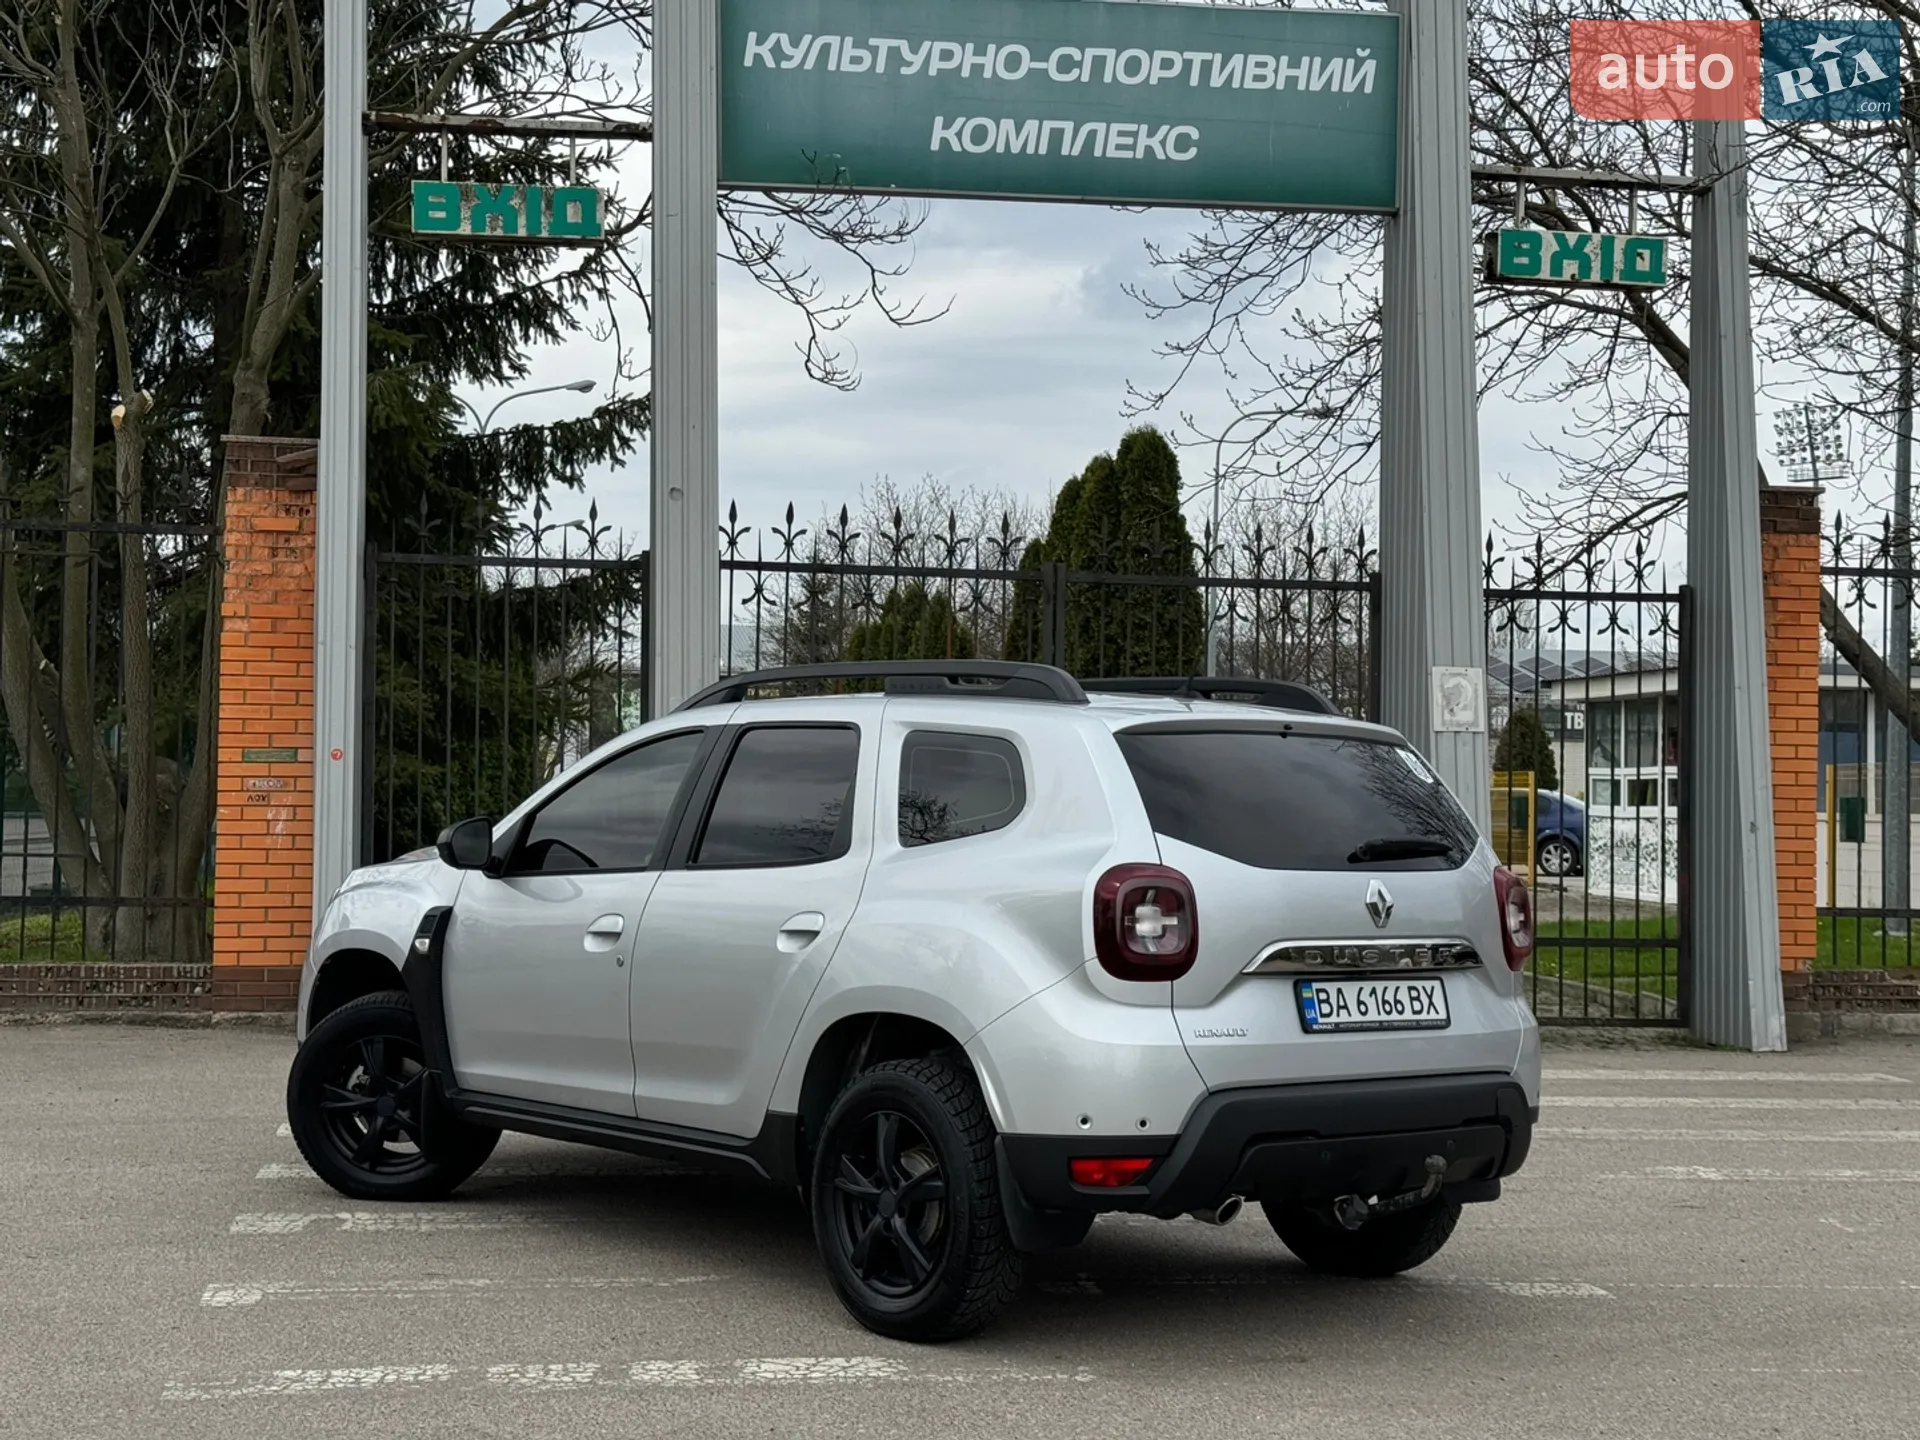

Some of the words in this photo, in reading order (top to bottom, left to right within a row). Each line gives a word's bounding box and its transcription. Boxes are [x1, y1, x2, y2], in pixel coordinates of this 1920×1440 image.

[744, 31, 1377, 94] КУЛЬТУРНО-СПОРТИВНИЙ
[930, 115, 1200, 162] КОМПЛЕКС
[413, 181, 602, 236] ВХІД
[1500, 229, 1666, 283] ВХІД
[1305, 947, 1454, 965] DUSTER
[1193, 1028, 1249, 1038] RENAULT
